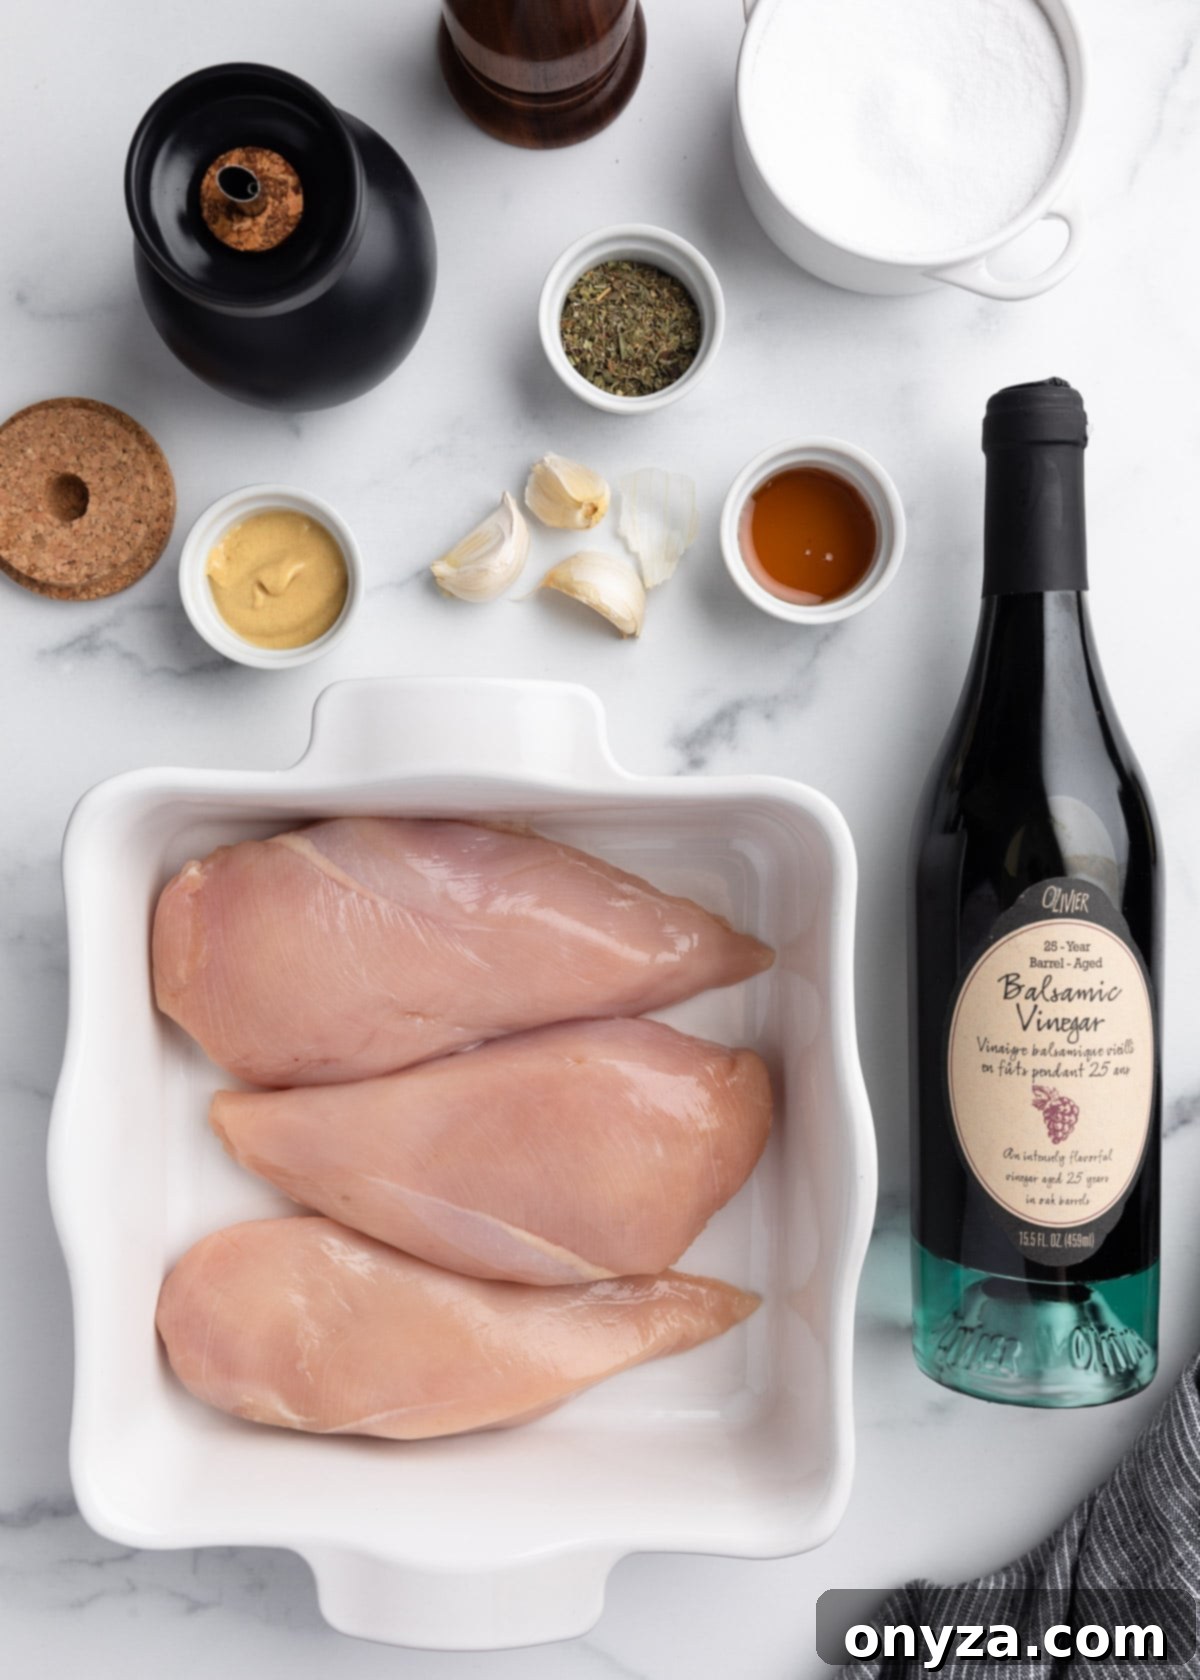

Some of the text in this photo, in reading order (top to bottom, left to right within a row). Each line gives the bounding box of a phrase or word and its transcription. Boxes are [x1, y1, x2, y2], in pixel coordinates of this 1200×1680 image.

[1042, 885, 1090, 913] OLIVIER
[1043, 941, 1058, 952] 25
[1066, 941, 1091, 952] Year
[1029, 957, 1065, 968] Barrel
[1073, 957, 1103, 971] Aged
[997, 972, 1123, 1002] Balsamic
[1015, 1003, 1105, 1044] Vinegar
[1031, 1042, 1103, 1062] balsamique
[1032, 1062, 1085, 1083] pendant
[1088, 1061, 1111, 1077] 25
[1002, 1147, 1021, 1160] An
[1005, 1171, 1039, 1187] vinegar
[1041, 1171, 1063, 1188] aged
[1066, 1171, 1084, 1184] 25
[1025, 1194, 1036, 1205] in
[1039, 1193, 1056, 1205] oak
